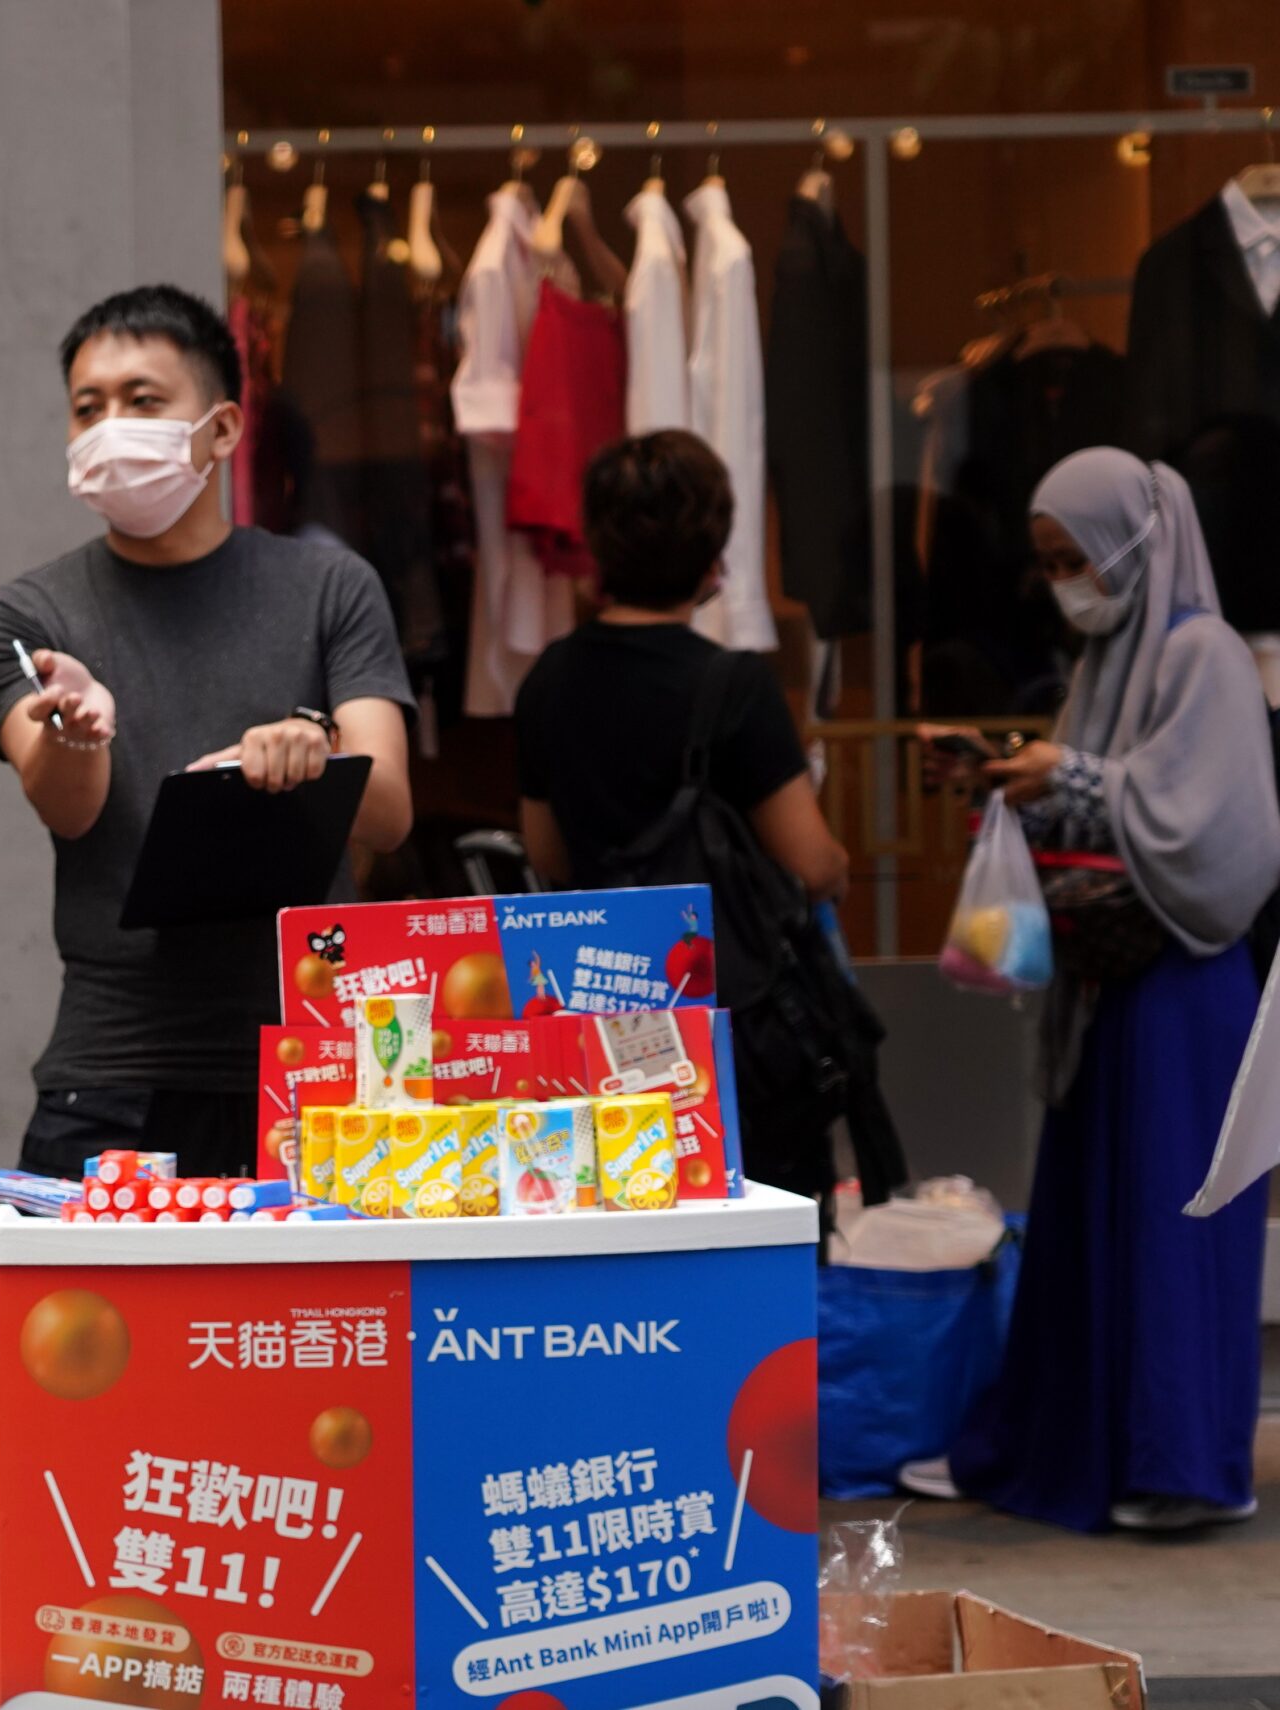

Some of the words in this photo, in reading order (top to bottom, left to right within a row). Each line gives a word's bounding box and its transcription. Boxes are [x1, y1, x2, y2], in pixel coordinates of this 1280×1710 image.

[406, 911, 488, 937] 天貓香港
[549, 909, 607, 927] BANK
[576, 945, 651, 977] 螞蟻銀行
[333, 957, 427, 1003] 狂歡吧!
[573, 967, 669, 1002] 雙11限時賞
[319, 1040, 356, 1059] 天貓
[290, 1308, 322, 1318] TMALL
[325, 1307, 387, 1317] HONGKONG
[188, 1320, 388, 1369] 天貓香港
[543, 1320, 682, 1358] BANK
[122, 1449, 344, 1540] 狂歡吧!
[481, 1448, 658, 1517] 螞蟻銀行
[488, 1491, 718, 1575] 雙11限時賞
[108, 1526, 281, 1609] 雙11!
[70, 1616, 176, 1647] 香港本地發貨
[541, 1639, 597, 1667] Bank
[604, 1626, 652, 1653] Mini
[252, 1642, 360, 1671] 官方配送免運費
